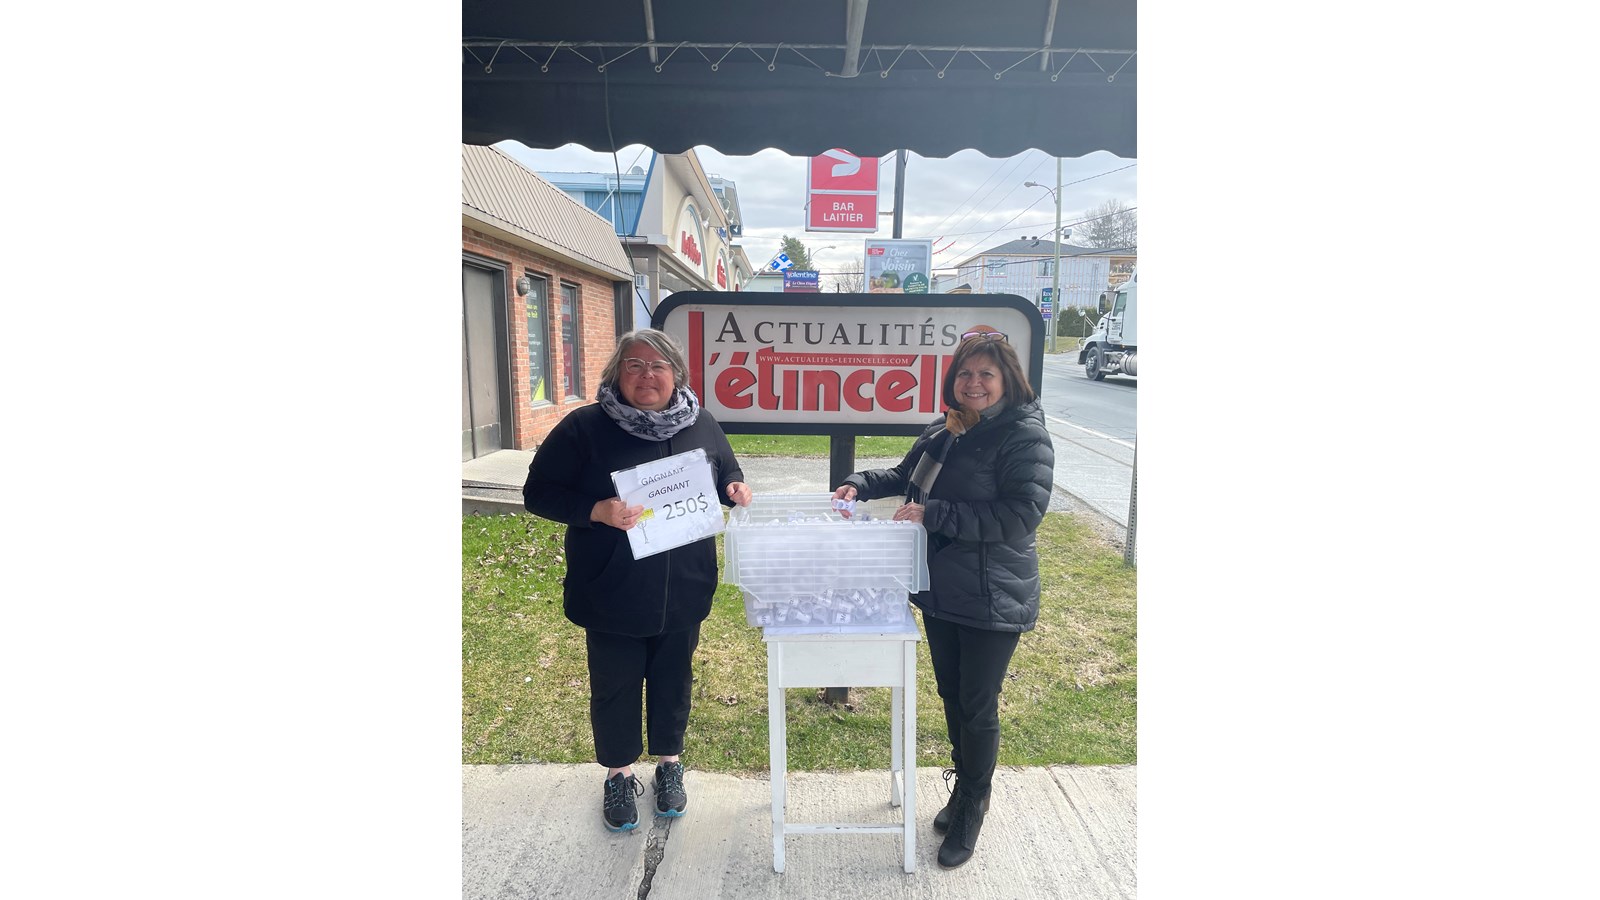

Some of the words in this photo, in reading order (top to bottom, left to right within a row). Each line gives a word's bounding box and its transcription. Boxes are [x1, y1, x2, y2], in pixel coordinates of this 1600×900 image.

[832, 202, 855, 211] BAR
[823, 212, 864, 222] LAITIER
[889, 248, 909, 257] Chez
[881, 257, 916, 271] Voisin
[714, 311, 958, 347] ACTUALITÉS
[759, 355, 909, 365] WWW.ACTUALITES-LETINCELLE.COM
[641, 466, 685, 486] GAGNANT
[648, 479, 690, 499] GAGNANT
[662, 492, 709, 521] 250$
